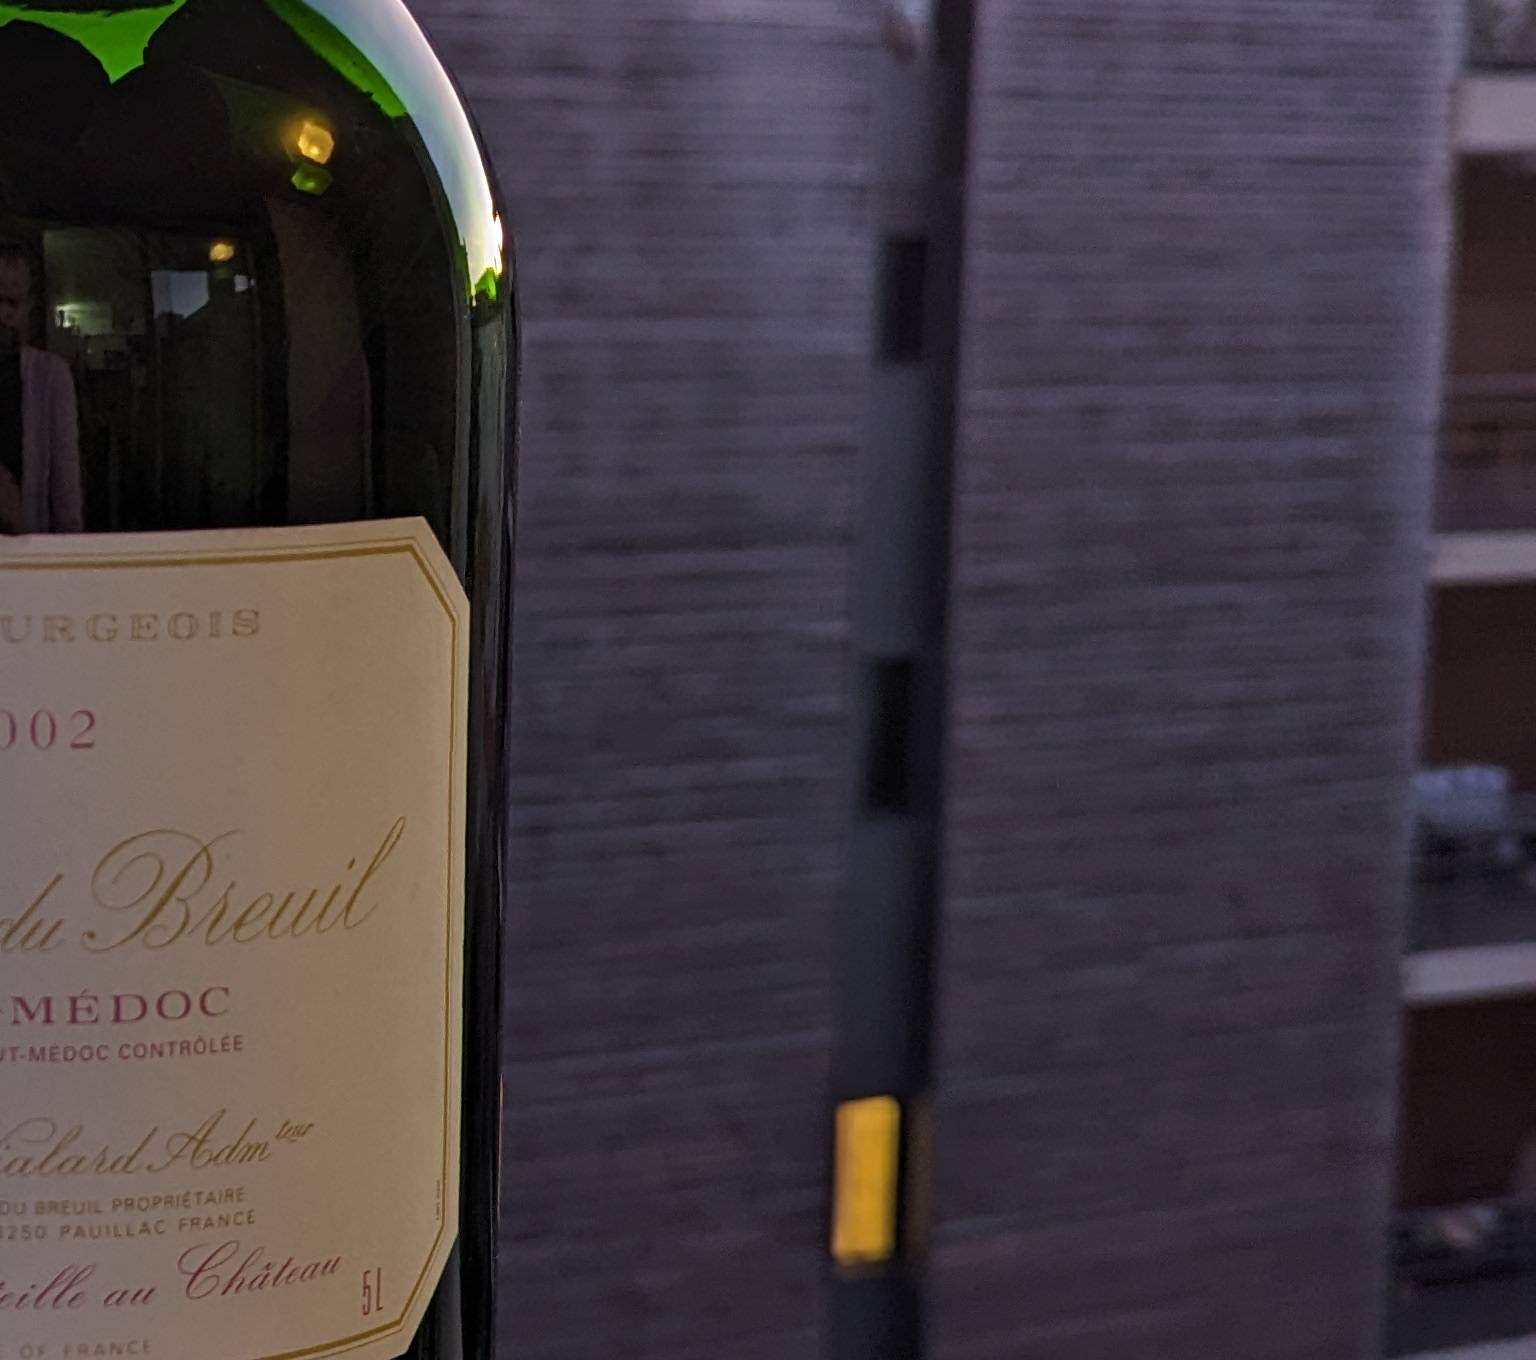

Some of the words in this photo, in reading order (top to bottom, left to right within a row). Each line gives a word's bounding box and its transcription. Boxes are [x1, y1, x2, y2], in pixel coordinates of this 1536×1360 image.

[81, 816, 407, 953] Breuil
[34, 1198, 104, 1216] BREUIL
[59, 1219, 165, 1240] PAUILLAC
[177, 1208, 256, 1232] FRANCE
[103, 1285, 156, 1307] au
[177, 1240, 342, 1300] Château
[18, 1343, 47, 1360] OF
[62, 1339, 152, 1360] FRANCE
